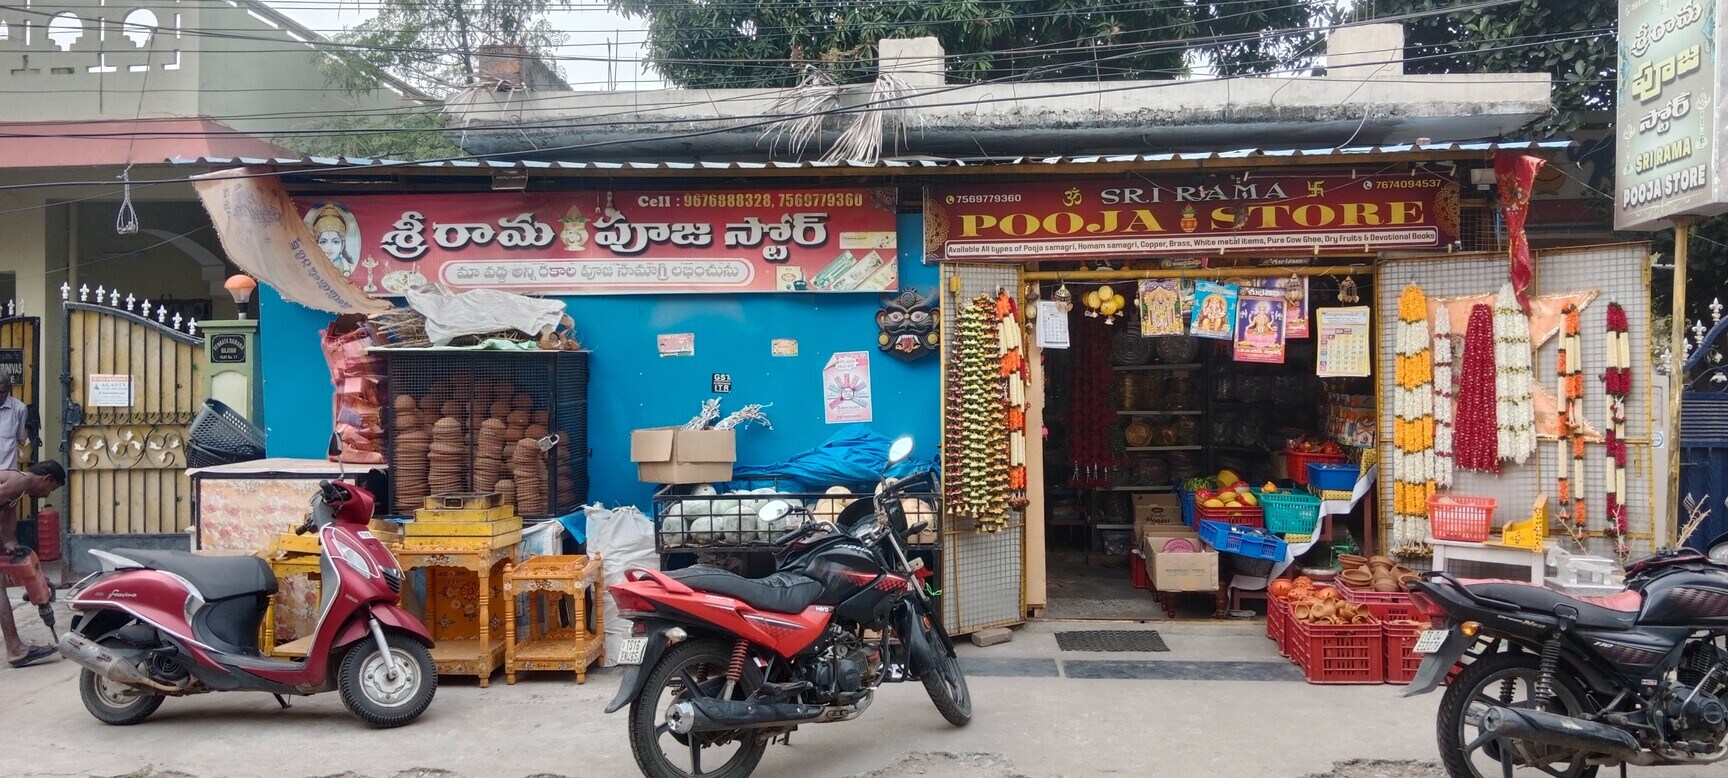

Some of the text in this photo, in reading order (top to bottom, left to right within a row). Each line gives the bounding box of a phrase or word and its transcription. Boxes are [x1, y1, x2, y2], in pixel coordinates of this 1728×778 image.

[1632, 44, 1700, 102] పూజ
[1640, 91, 1691, 133] స్టోర్
[1636, 137, 1691, 173] SRI RAMA
[956, 193, 1022, 204] 7569779360
[1101, 181, 1288, 205] SRI RAMA
[1376, 179, 1441, 190] 7674094537
[1623, 164, 1706, 208] POOJA STORE
[638, 195, 671, 207] Cell
[683, 193, 774, 208] 9676888328,
[778, 193, 863, 207] 7569779360
[593, 209, 713, 253] పూజ
[724, 212, 828, 260] స్టోర్
[957, 201, 1425, 238] POOJA STORE
[948, 244, 980, 253] Available
[981, 244, 990, 252] All
[991, 244, 1013, 254] types
[1014, 244, 1022, 252] of
[1023, 244, 1044, 253] Pooja
[1045, 243, 1077, 252] samagri,
[1078, 242, 1105, 250] Homam
[1107, 241, 1139, 250] samagri,
[1140, 240, 1168, 249] Copper,
[1169, 239, 1193, 247] Brass,
[1194, 238, 1216, 246] White
[1217, 237, 1240, 245] metal
[1241, 237, 1266, 246] items,
[1267, 236, 1285, 244] Pure
[1303, 235, 1323, 243] Ghee,
[1325, 235, 1338, 243] Dry
[1339, 234, 1362, 242] Fruits
[1364, 233, 1369, 241] &
[1370, 232, 1411, 241] Devotional
[1412, 231, 1435, 240] Books
[456, 265, 480, 279] మా
[484, 265, 508, 283] వద్ద
[581, 264, 613, 280] పూజ
